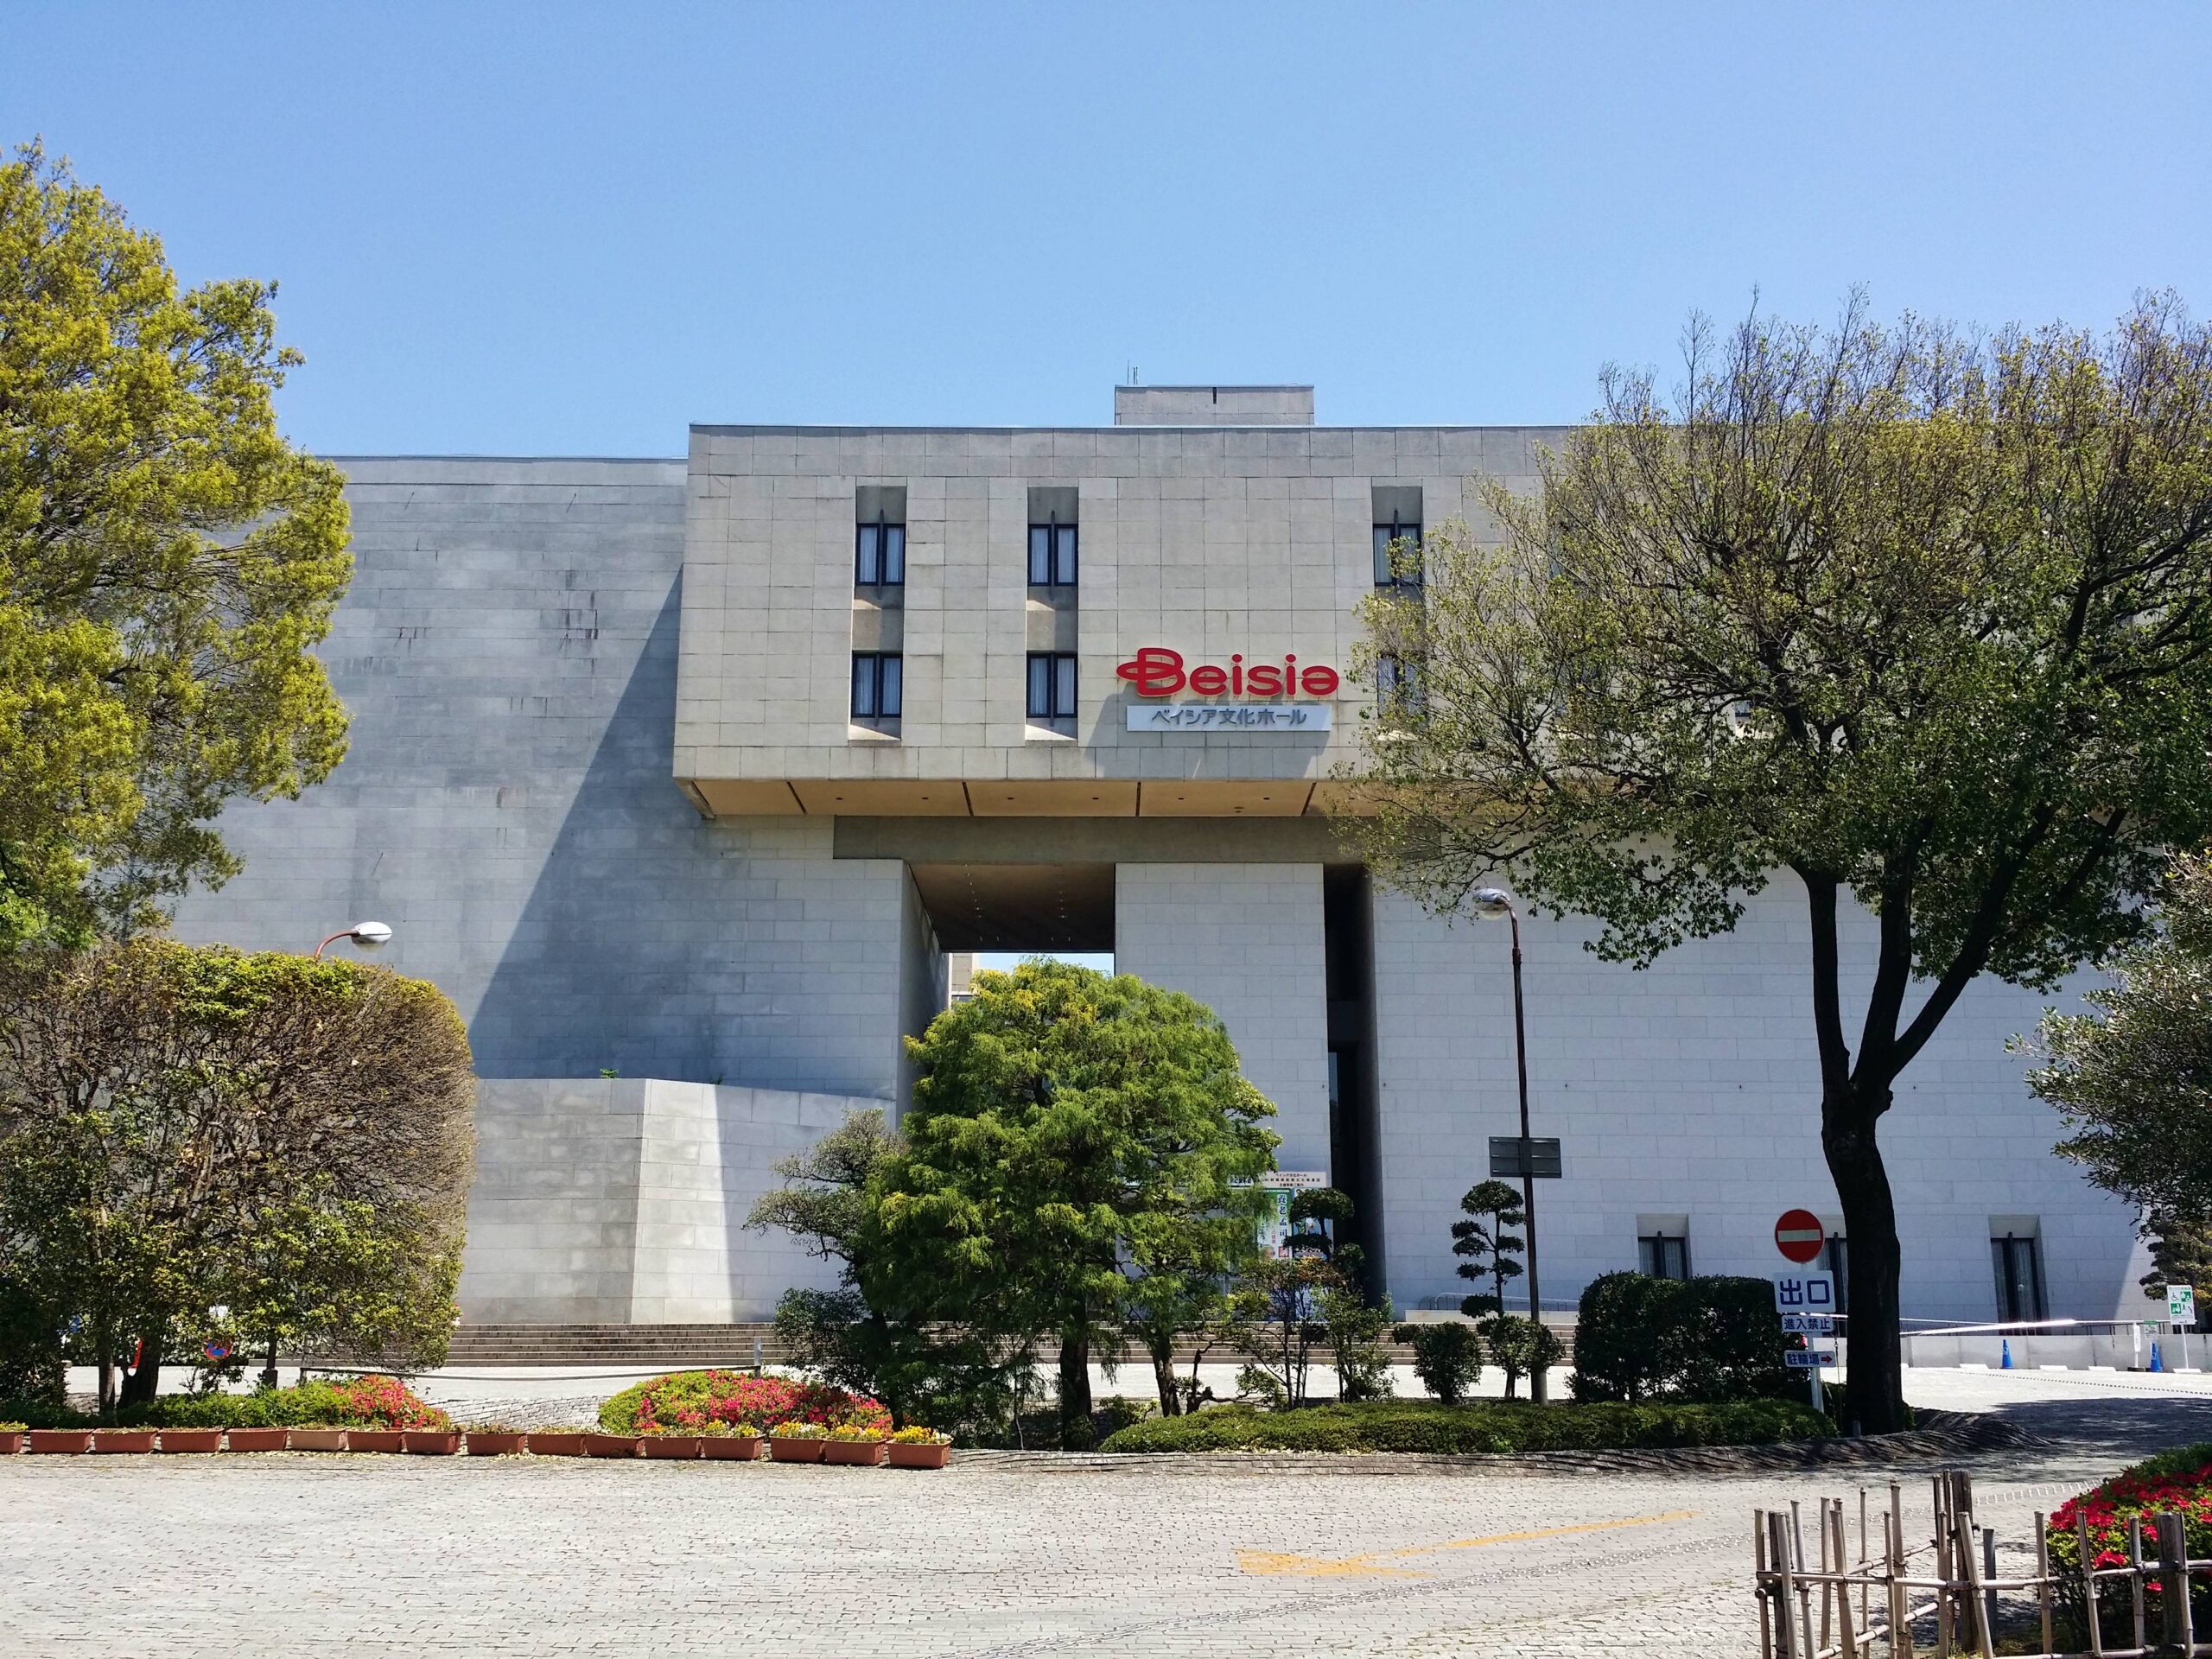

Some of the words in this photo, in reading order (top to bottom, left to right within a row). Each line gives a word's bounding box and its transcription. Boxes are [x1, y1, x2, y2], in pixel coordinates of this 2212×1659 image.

[1116, 647, 1339, 696] Beisia
[1151, 708, 1307, 726] ベイシア文化ホール
[1779, 1279, 1830, 1305] 出口
[1783, 1318, 1831, 1330] 進入禁止
[1786, 1353, 1820, 1365] 駐輪場
